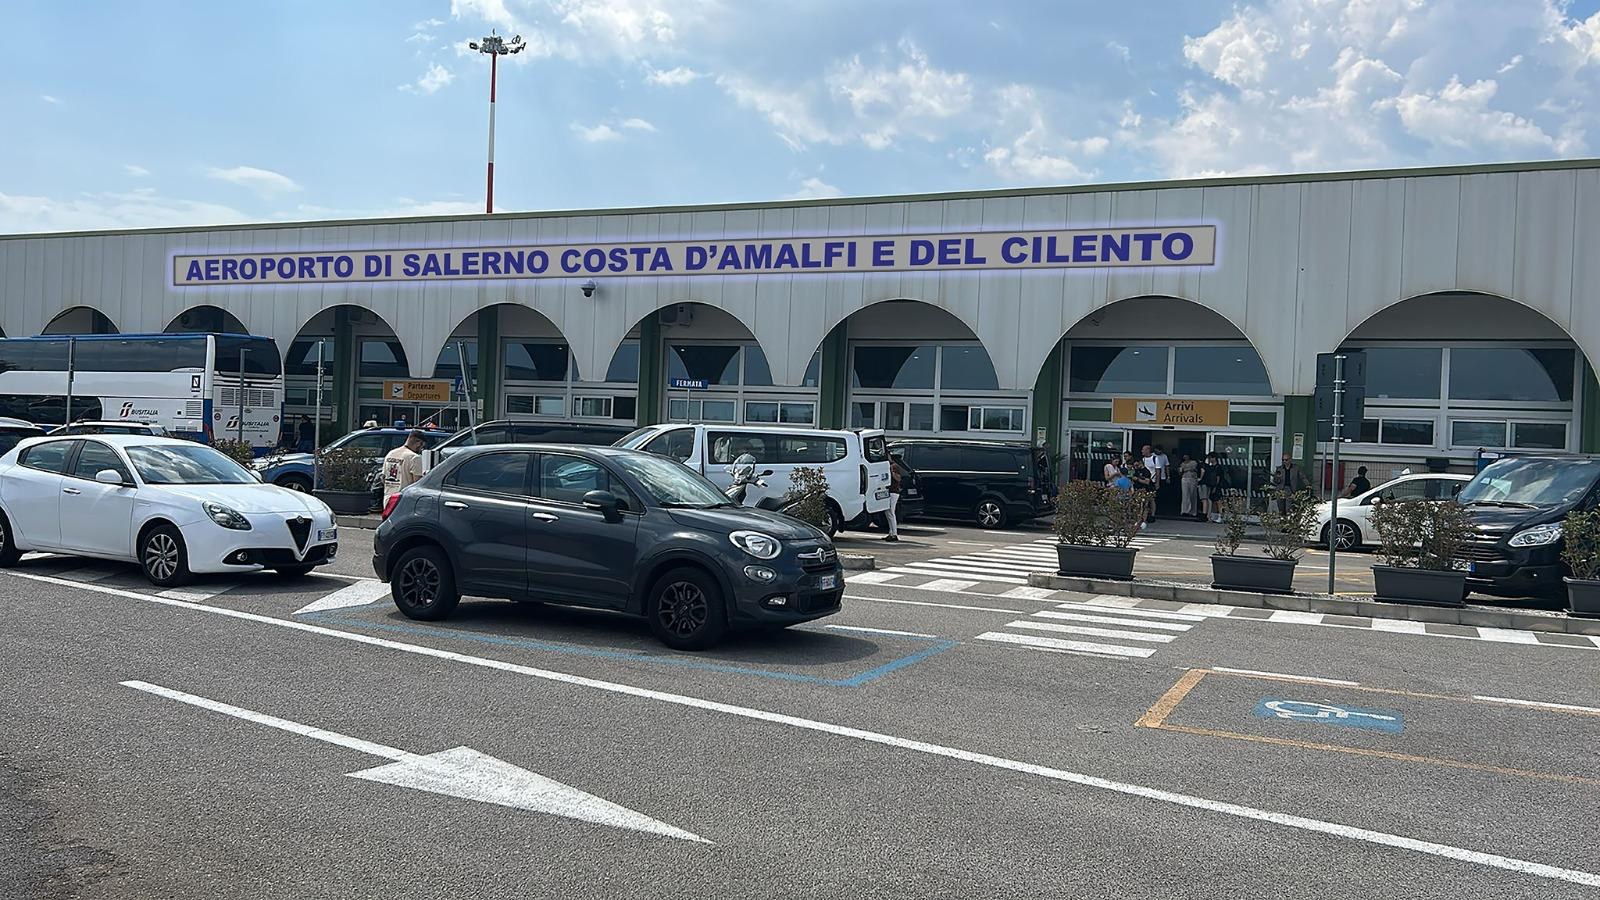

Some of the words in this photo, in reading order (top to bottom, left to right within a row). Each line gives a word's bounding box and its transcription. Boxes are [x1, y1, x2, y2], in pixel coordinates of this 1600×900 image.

[185, 256, 354, 281] AEROPORTO
[364, 255, 392, 278] DI
[402, 250, 549, 277] SALERNO
[560, 247, 673, 273] COSTA
[685, 242, 857, 271] D’AMALFI
[872, 240, 895, 267] E
[909, 238, 987, 266] DEL
[1001, 232, 1194, 263] CILENTO
[407, 382, 436, 390] Partenze
[676, 379, 703, 388] FERMATA
[407, 391, 441, 400] Departures
[1164, 401, 1194, 411] Arrivi
[1164, 413, 1204, 424] Arrivals
